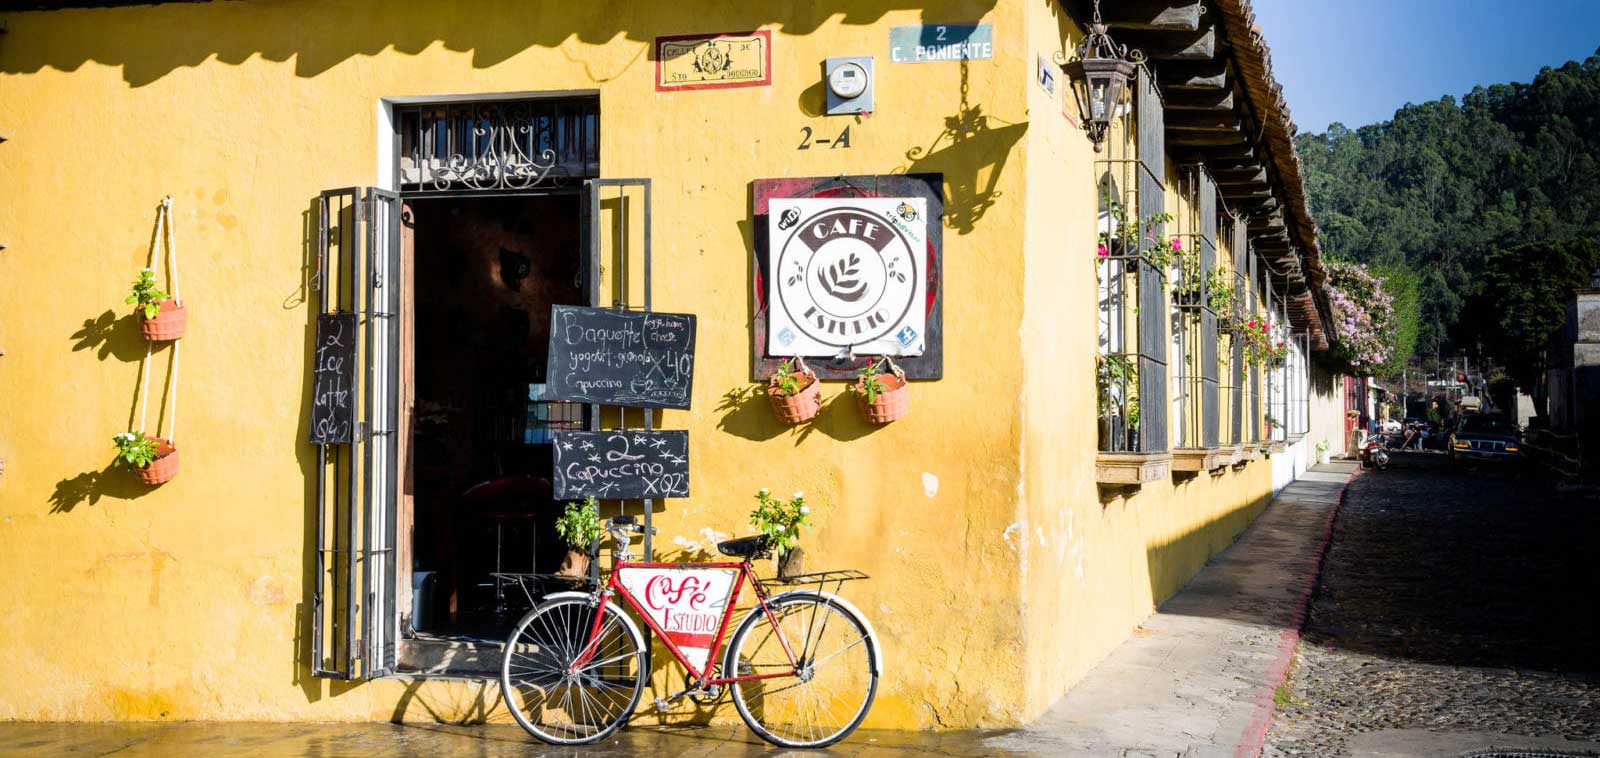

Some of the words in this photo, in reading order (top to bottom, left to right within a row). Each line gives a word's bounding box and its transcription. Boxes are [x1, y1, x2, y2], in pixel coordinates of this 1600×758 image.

[936, 25, 947, 41] 2
[892, 46, 908, 62] C.
[915, 42, 992, 61] PONIENTE
[797, 125, 851, 150] 2-A
[812, 218, 881, 241] CAFE
[327, 318, 344, 347] 2
[314, 346, 344, 374] Ice
[606, 435, 645, 462] 2
[645, 574, 712, 611] Café
